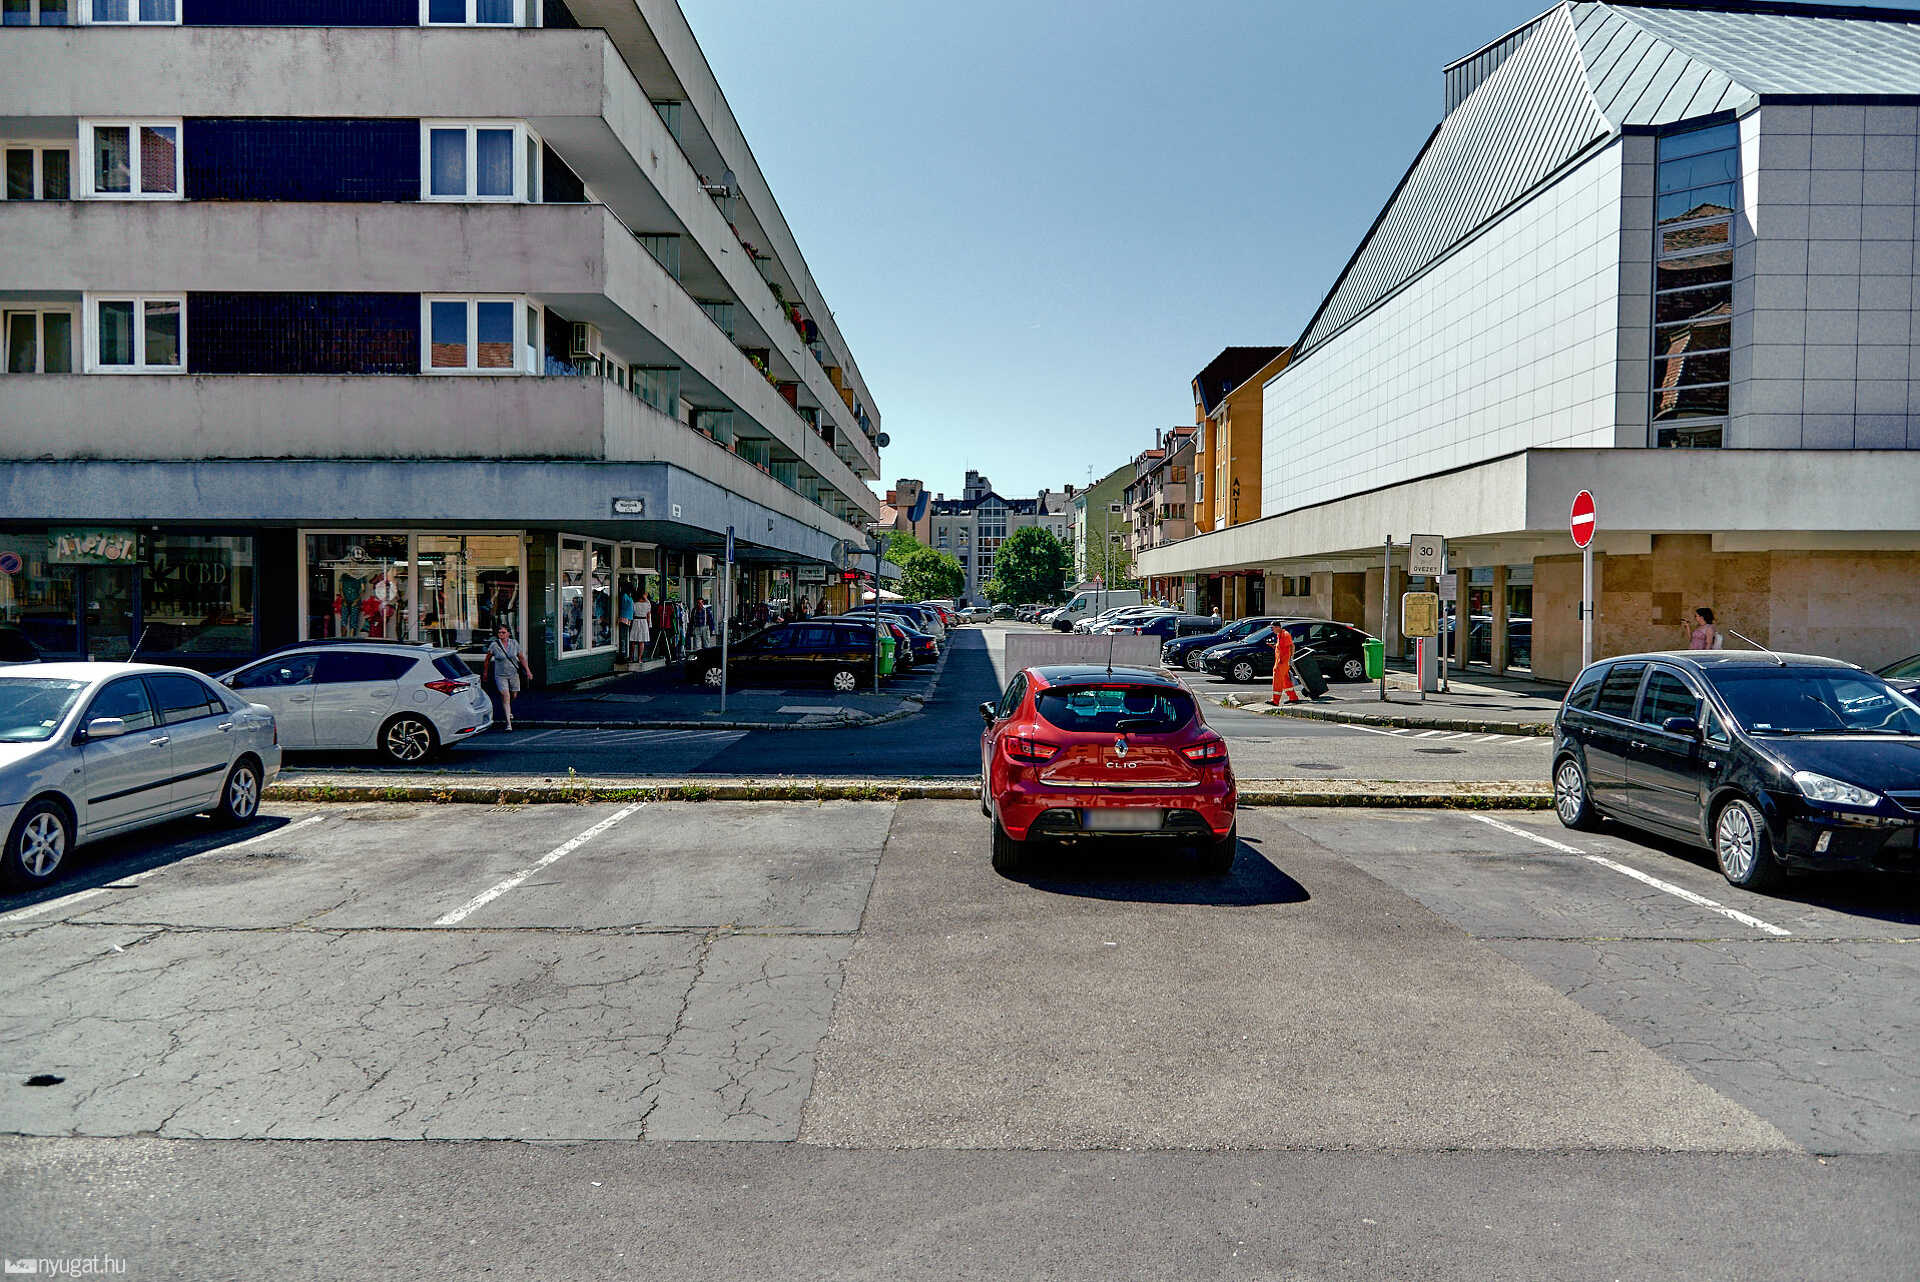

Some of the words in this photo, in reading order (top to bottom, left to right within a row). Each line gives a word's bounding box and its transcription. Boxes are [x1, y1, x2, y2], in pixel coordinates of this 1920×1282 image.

[1419, 546, 1433, 556] 30
[185, 562, 227, 584] CBD
[1006, 638, 1056, 657] Prima
[1063, 638, 1104, 657] Pizza
